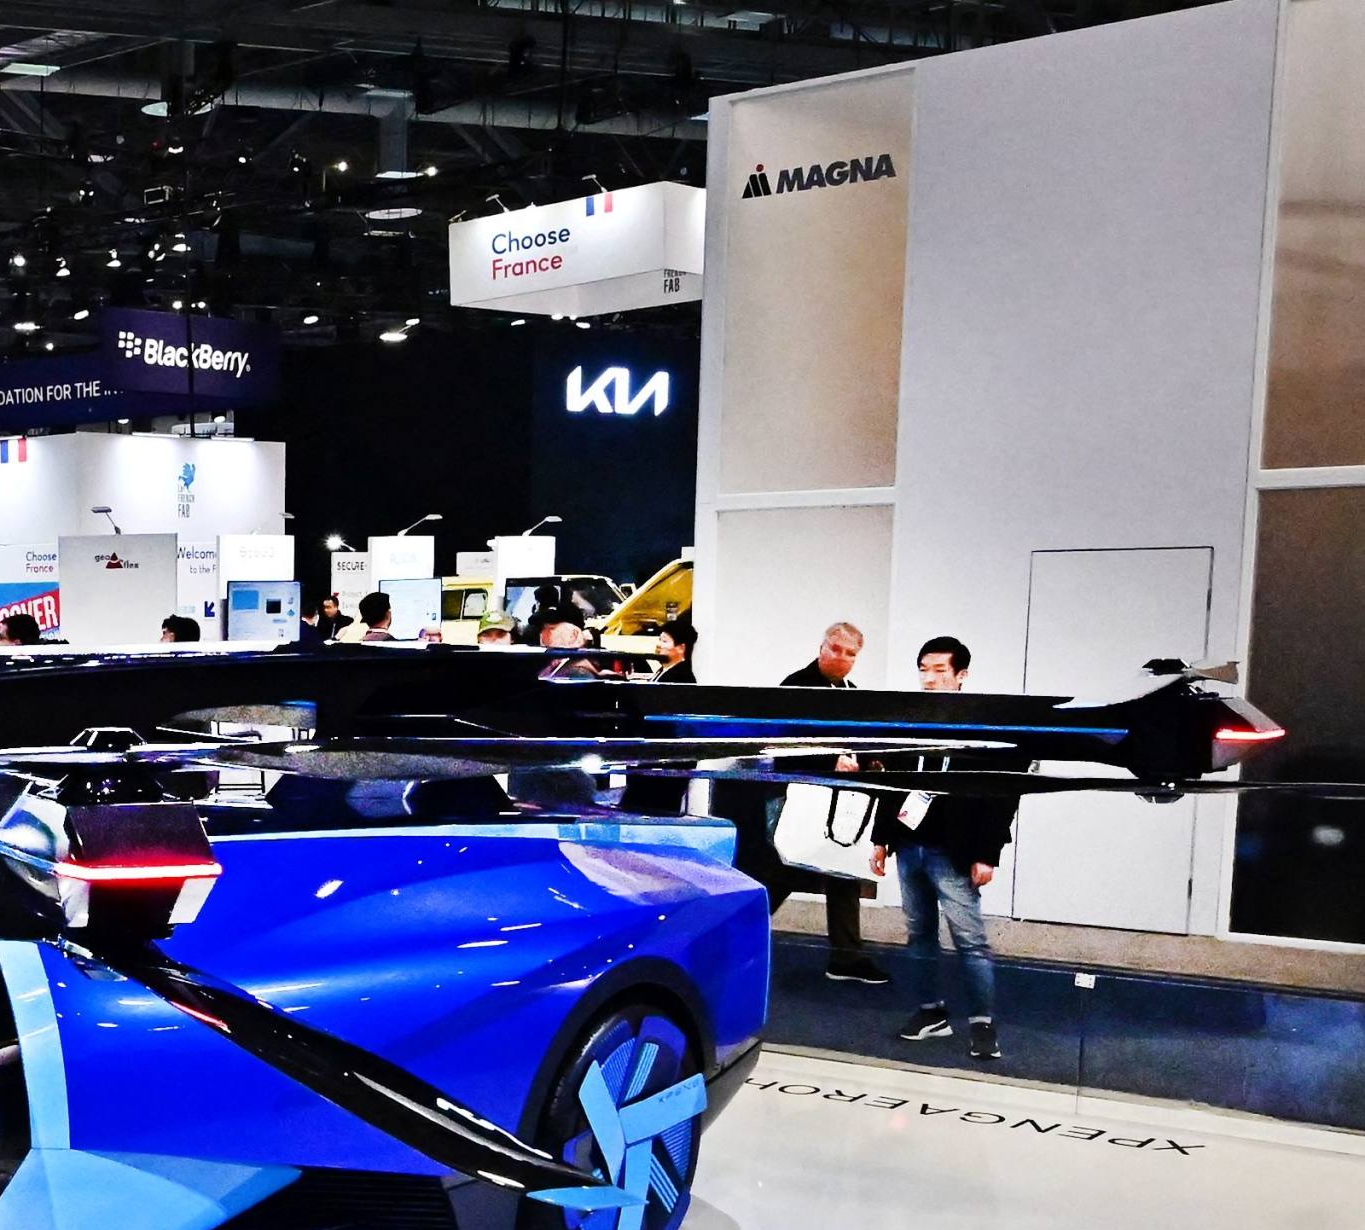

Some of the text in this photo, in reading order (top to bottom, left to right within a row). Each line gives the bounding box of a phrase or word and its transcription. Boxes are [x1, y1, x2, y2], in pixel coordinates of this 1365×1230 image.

[776, 154, 897, 194] MAGNA
[492, 228, 571, 254] Choose
[492, 255, 563, 280] France
[664, 278, 680, 293] FAB
[46, 384, 72, 402] FOR
[74, 380, 101, 398] THE
[26, 552, 57, 562] Choose
[26, 563, 54, 574] France
[189, 565, 198, 574] to
[199, 565, 211, 574] the
